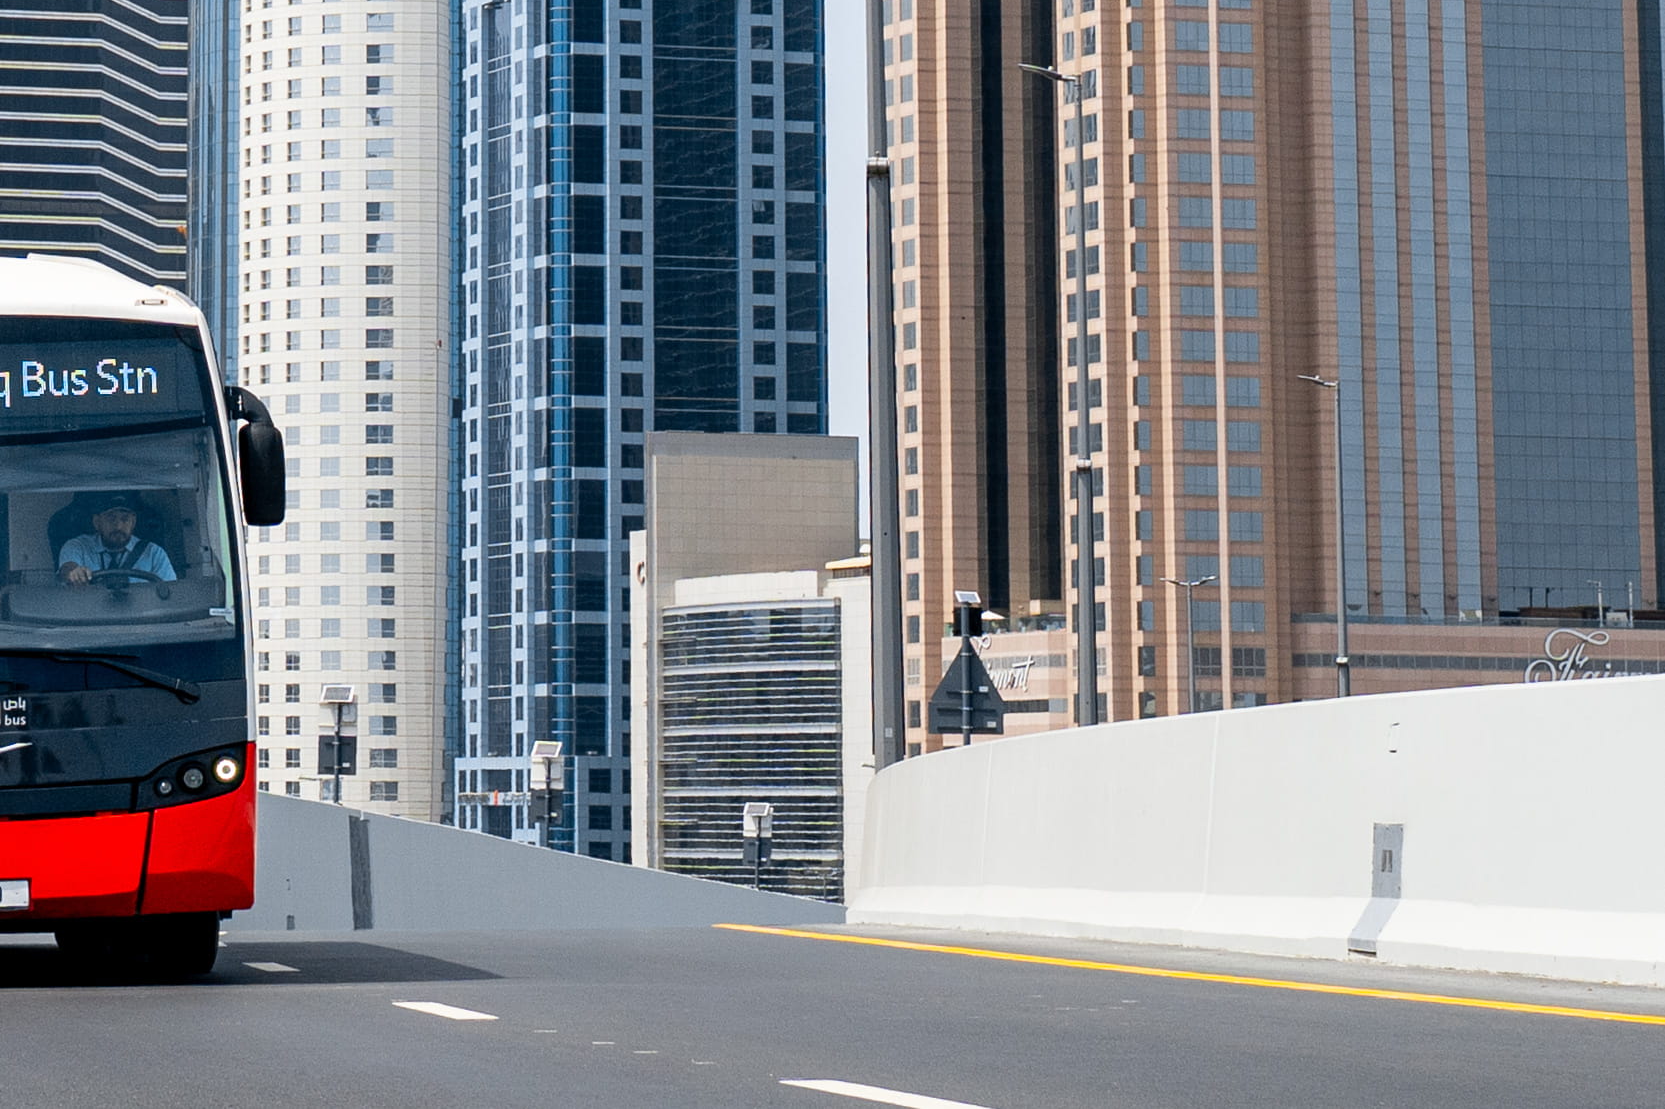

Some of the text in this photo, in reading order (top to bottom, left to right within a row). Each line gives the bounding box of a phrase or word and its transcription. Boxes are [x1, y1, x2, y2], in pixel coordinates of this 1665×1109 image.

[22, 360, 89, 398] Bus
[96, 358, 158, 395] Stn
[4, 715, 27, 726] bus
